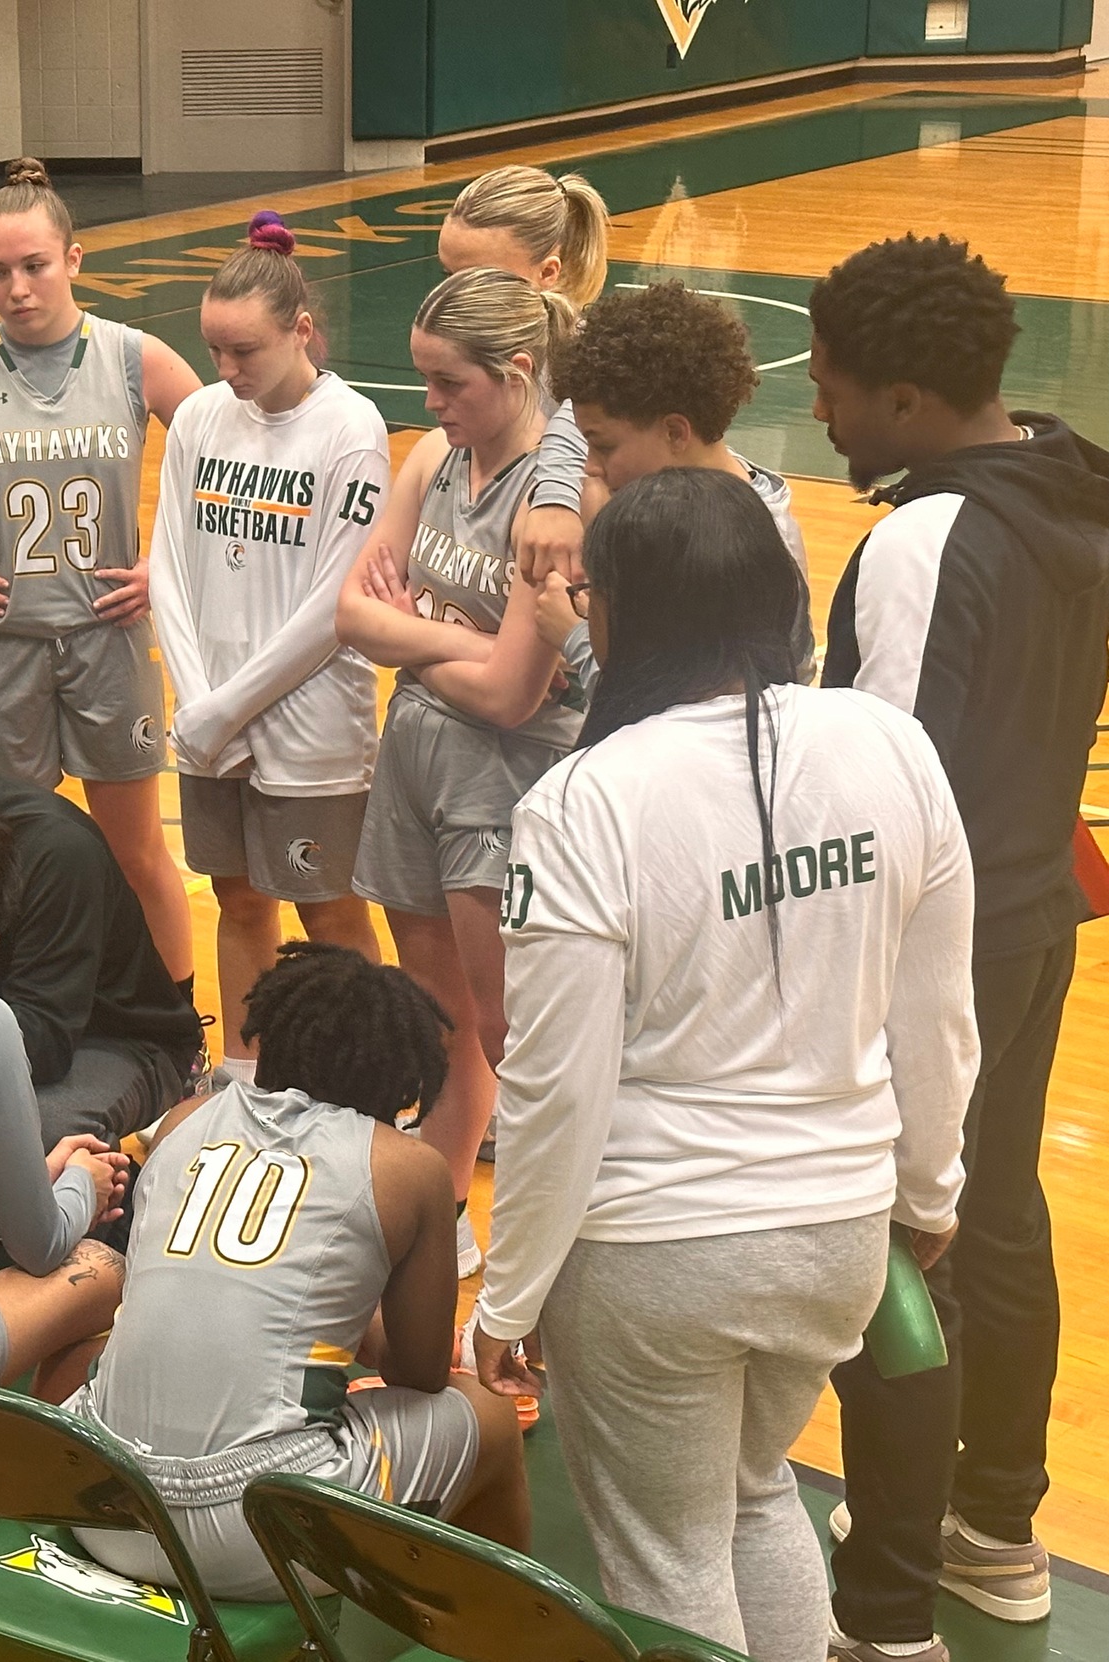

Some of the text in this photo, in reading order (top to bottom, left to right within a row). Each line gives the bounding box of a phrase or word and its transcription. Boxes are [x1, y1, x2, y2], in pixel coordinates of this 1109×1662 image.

[6, 475, 103, 576] 23
[195, 501, 306, 547] ASKETBALL
[338, 479, 381, 526] 15
[721, 831, 876, 921] MOORE
[163, 1139, 313, 1268] 10
